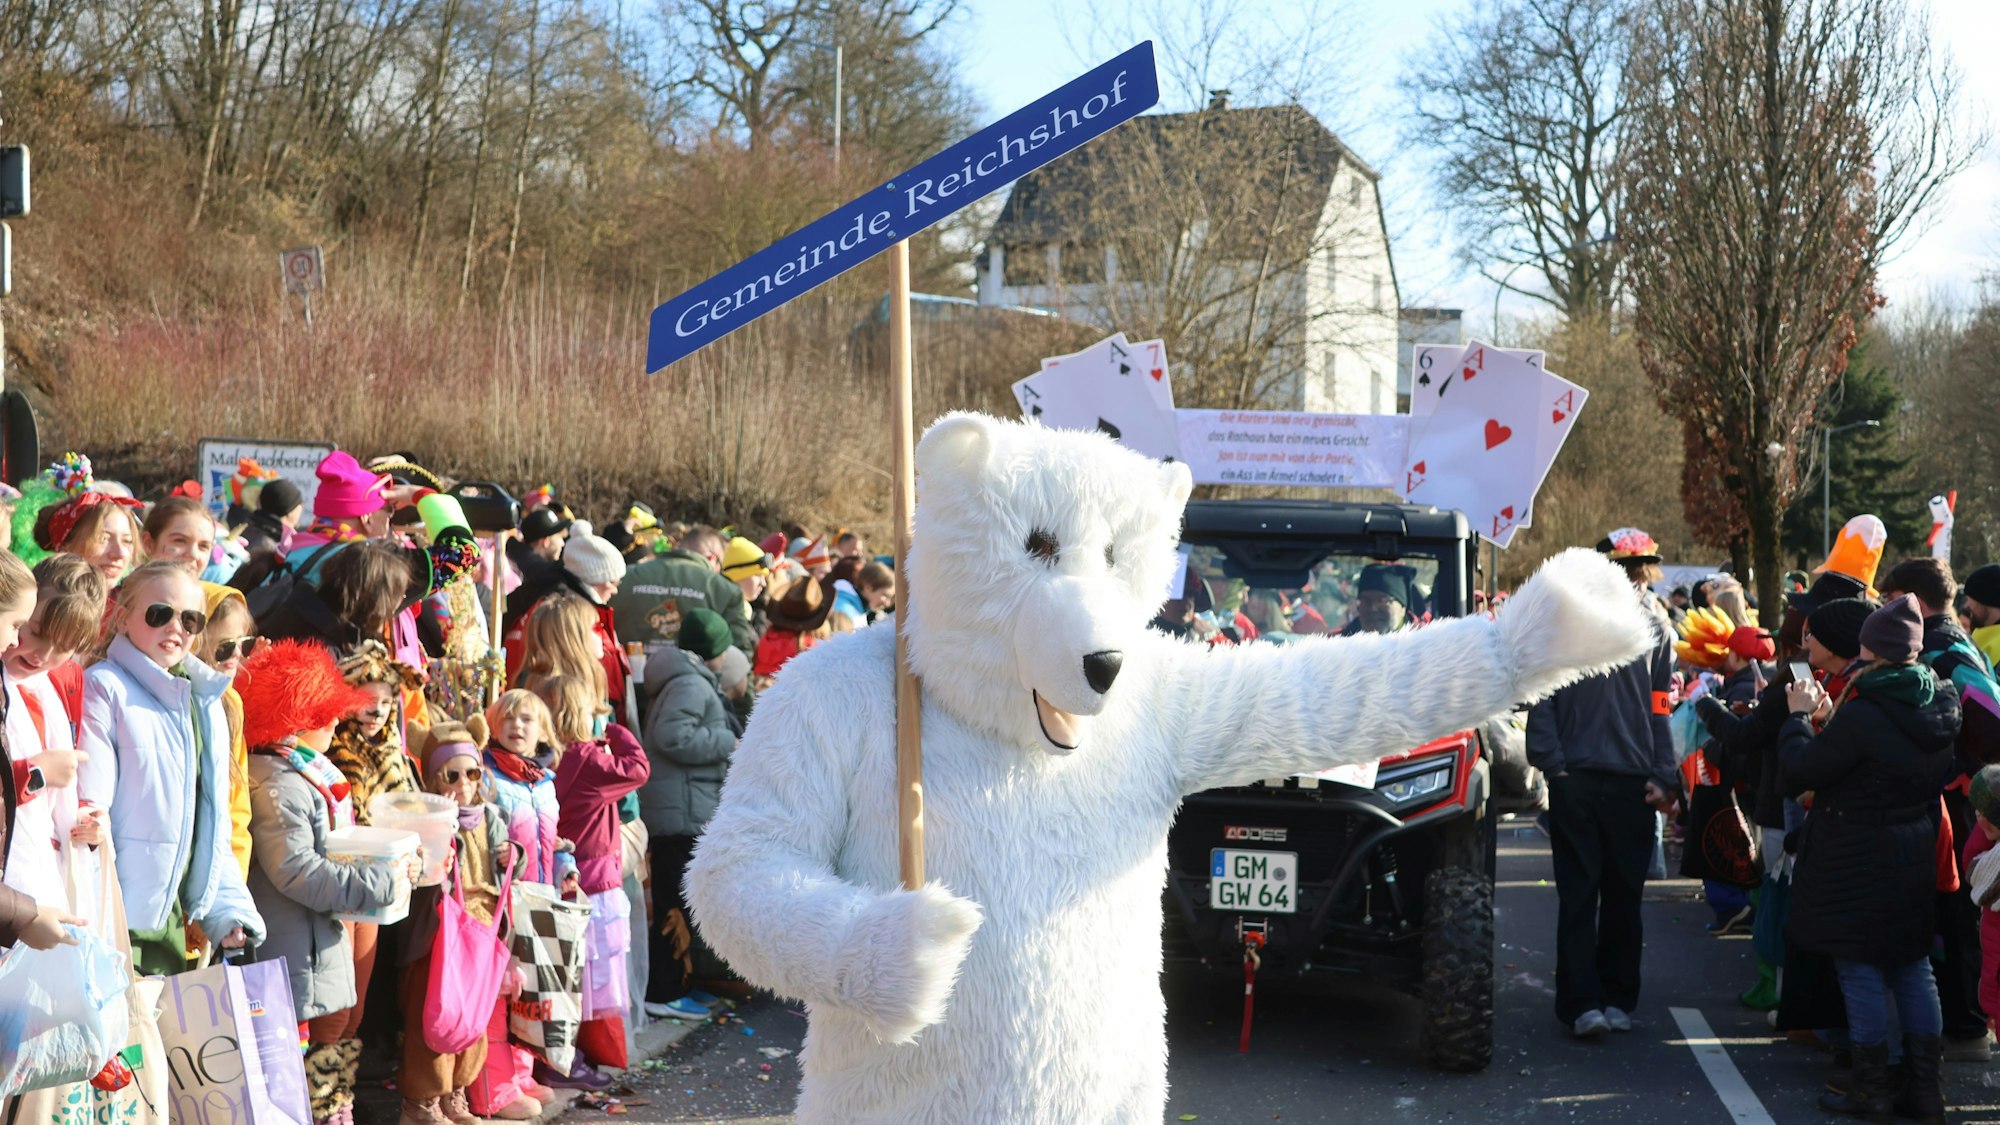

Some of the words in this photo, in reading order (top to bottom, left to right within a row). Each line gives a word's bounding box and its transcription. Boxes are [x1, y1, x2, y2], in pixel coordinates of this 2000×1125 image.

[674, 209, 891, 338] Gemeinde
[904, 70, 1128, 219] Reichshof
[1110, 341, 1128, 364] A
[1147, 343, 1159, 367] 7
[1419, 347, 1433, 370] 6
[1464, 348, 1485, 372] A
[1023, 383, 1041, 406] A
[1554, 389, 1573, 413] A
[1219, 412, 1234, 423] Die
[1237, 413, 1268, 425] Karten
[1271, 413, 1291, 425] sind
[1208, 430, 1224, 442] das
[1227, 431, 1265, 443] Rathaus
[1267, 431, 1284, 443] hat
[1286, 432, 1301, 444] ein
[1302, 435, 1331, 445] neues
[1270, 451, 1285, 463] mit
[1307, 452, 1323, 464] der
[1220, 468, 1235, 480] ein
[1237, 469, 1252, 480] Ass
[1254, 469, 1267, 480] im
[1269, 467, 1298, 481] Ärmel
[1299, 471, 1336, 483] schadet
[1406, 472, 1426, 494] A
[1492, 514, 1512, 538] A
[632, 585, 669, 596] FREEDOM
[670, 587, 680, 596] TO
[681, 588, 705, 600] ROAM
[1225, 826, 1288, 842] AODES
[1234, 855, 1268, 880] GM
[1219, 881, 1252, 906] GW
[1258, 884, 1289, 908] 64
